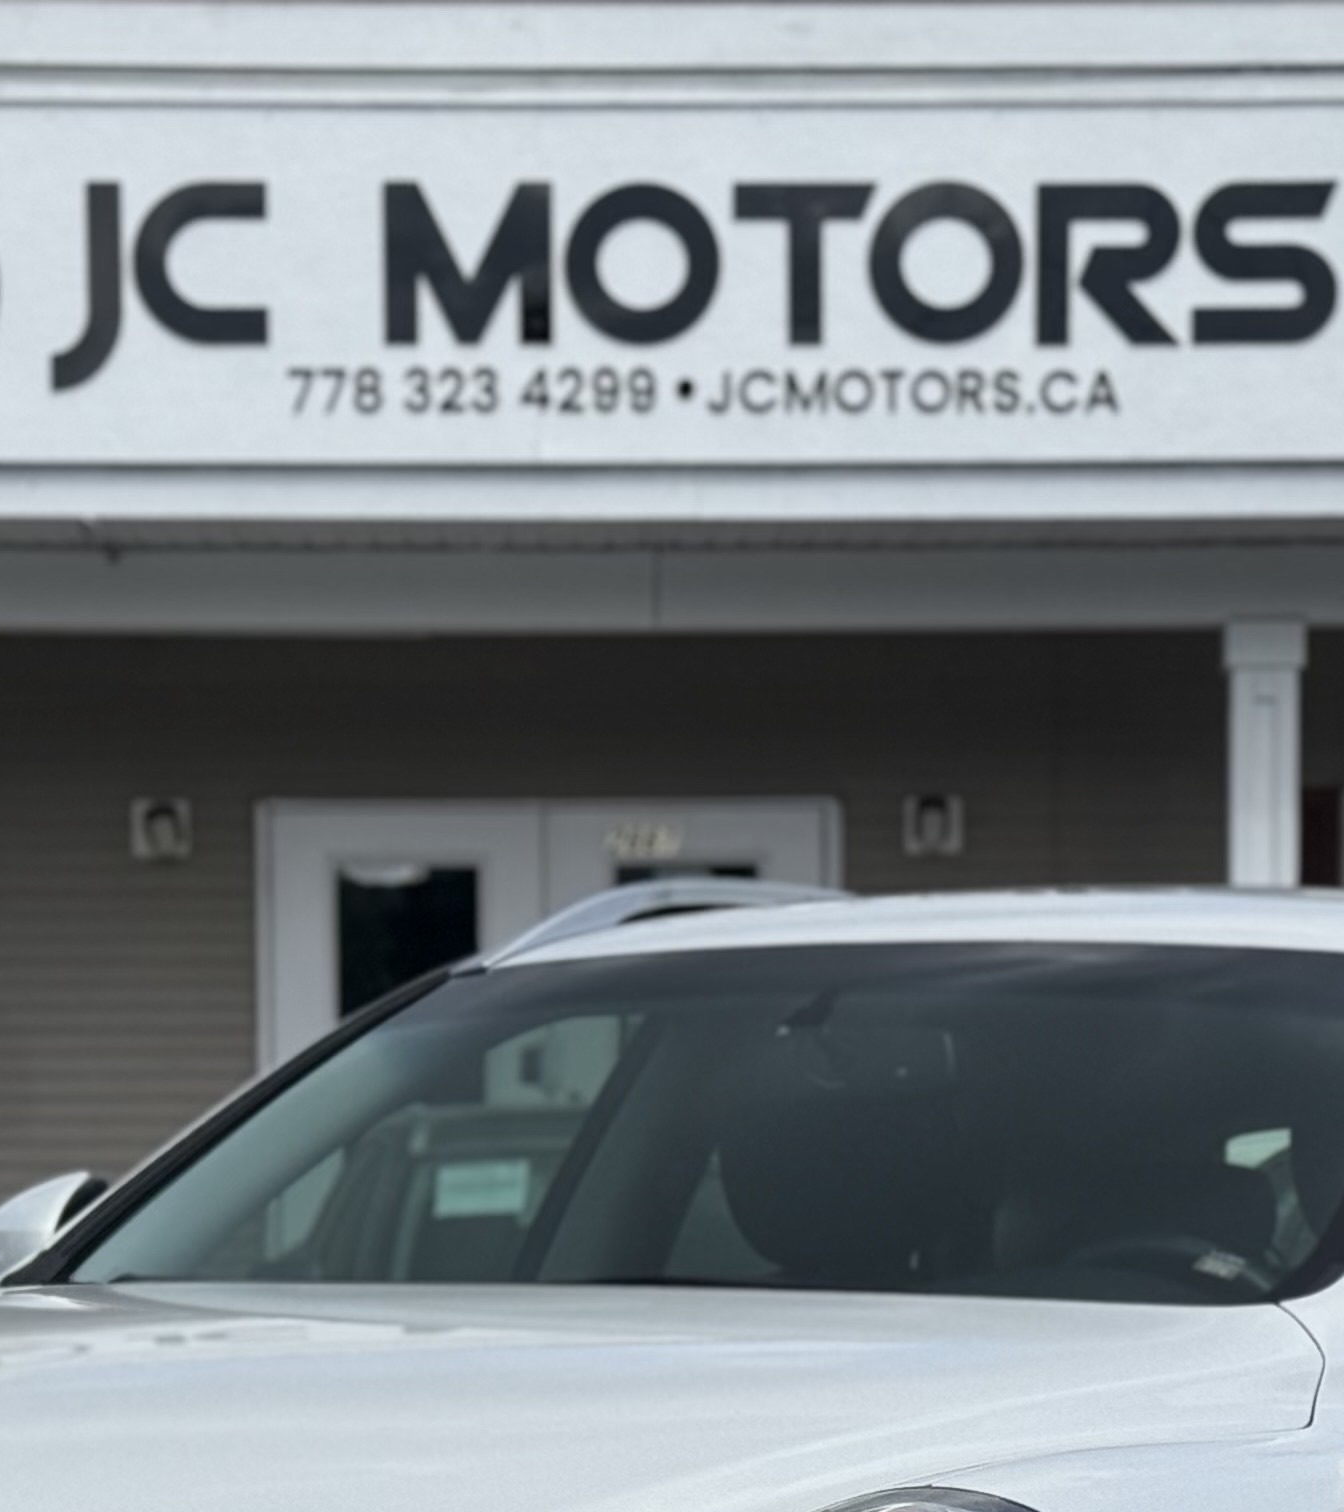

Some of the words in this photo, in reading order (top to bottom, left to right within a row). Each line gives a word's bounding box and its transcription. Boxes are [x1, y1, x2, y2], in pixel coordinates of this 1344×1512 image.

[51, 181, 270, 393] JC
[381, 180, 1339, 348] MOTORS
[289, 368, 381, 414] 778
[407, 367, 497, 413] 323
[521, 368, 655, 413] 4299
[709, 370, 1118, 415] JCMOTORS.CA
